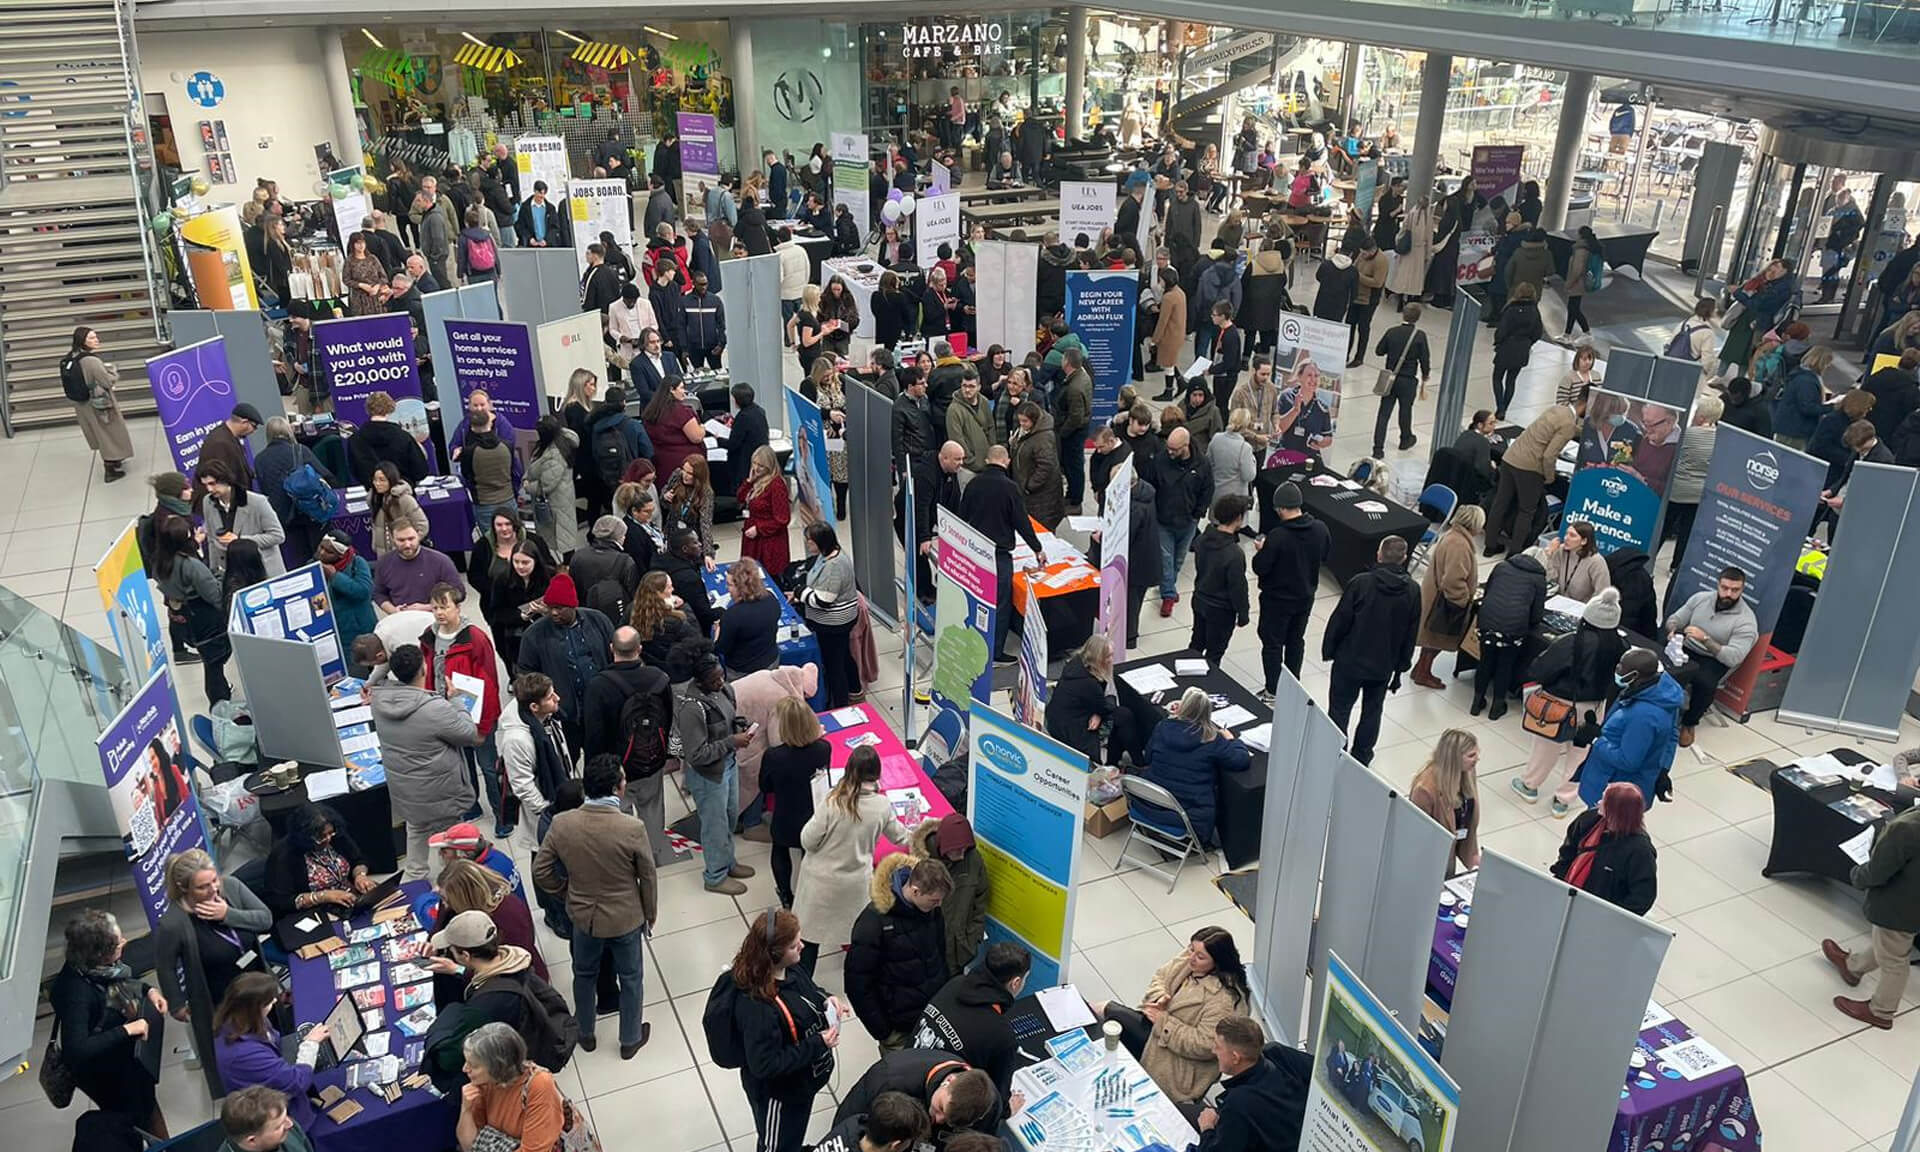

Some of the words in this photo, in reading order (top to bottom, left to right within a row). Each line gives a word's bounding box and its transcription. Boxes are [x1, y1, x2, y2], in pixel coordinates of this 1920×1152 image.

[902, 23, 1002, 45] MARZANO
[902, 47, 942, 58] CAFE
[953, 46, 961, 56] &
[974, 44, 1002, 56] BAR
[520, 142, 537, 153] JOBS
[573, 186, 594, 198] JOBS
[1086, 204, 1104, 212] JOBS
[926, 218, 938, 227] UEA
[939, 217, 953, 226] JOBS
[1080, 291, 1102, 299] BEGIN
[1102, 291, 1123, 299] YOUR
[326, 342, 363, 356] What
[364, 336, 404, 351] would
[452, 331, 469, 341] Get
[470, 332, 481, 341] all
[482, 334, 502, 344] your
[454, 343, 480, 353] home
[481, 346, 518, 355] services
[330, 359, 356, 373] you
[358, 355, 376, 367] do
[378, 351, 407, 364] with
[456, 355, 465, 364] in
[466, 357, 486, 366] one,
[487, 357, 515, 367] simple
[334, 365, 410, 387] £20,000?
[458, 368, 494, 378] monthly
[495, 368, 508, 377] bill
[338, 394, 353, 402] Free
[176, 431, 196, 444] Earn
[180, 444, 198, 456] own
[1746, 459, 1780, 480] norse
[1601, 478, 1628, 493] norse
[1716, 482, 1741, 500] OUR
[1741, 492, 1793, 522] SERVICES
[1582, 497, 1622, 522] Make
[1622, 514, 1633, 526] a
[968, 538, 993, 564] Education
[995, 744, 1022, 764] norvic
[1045, 768, 1071, 786] Career
[1033, 772, 1081, 801] Opportunities
[936, 1014, 964, 1051] PUMPED
[1729, 1096, 1743, 1116] step
[1320, 1096, 1339, 1123] What
[1342, 1120, 1354, 1138] We
[1680, 1114, 1690, 1132] step
[1650, 1122, 1664, 1140] step
